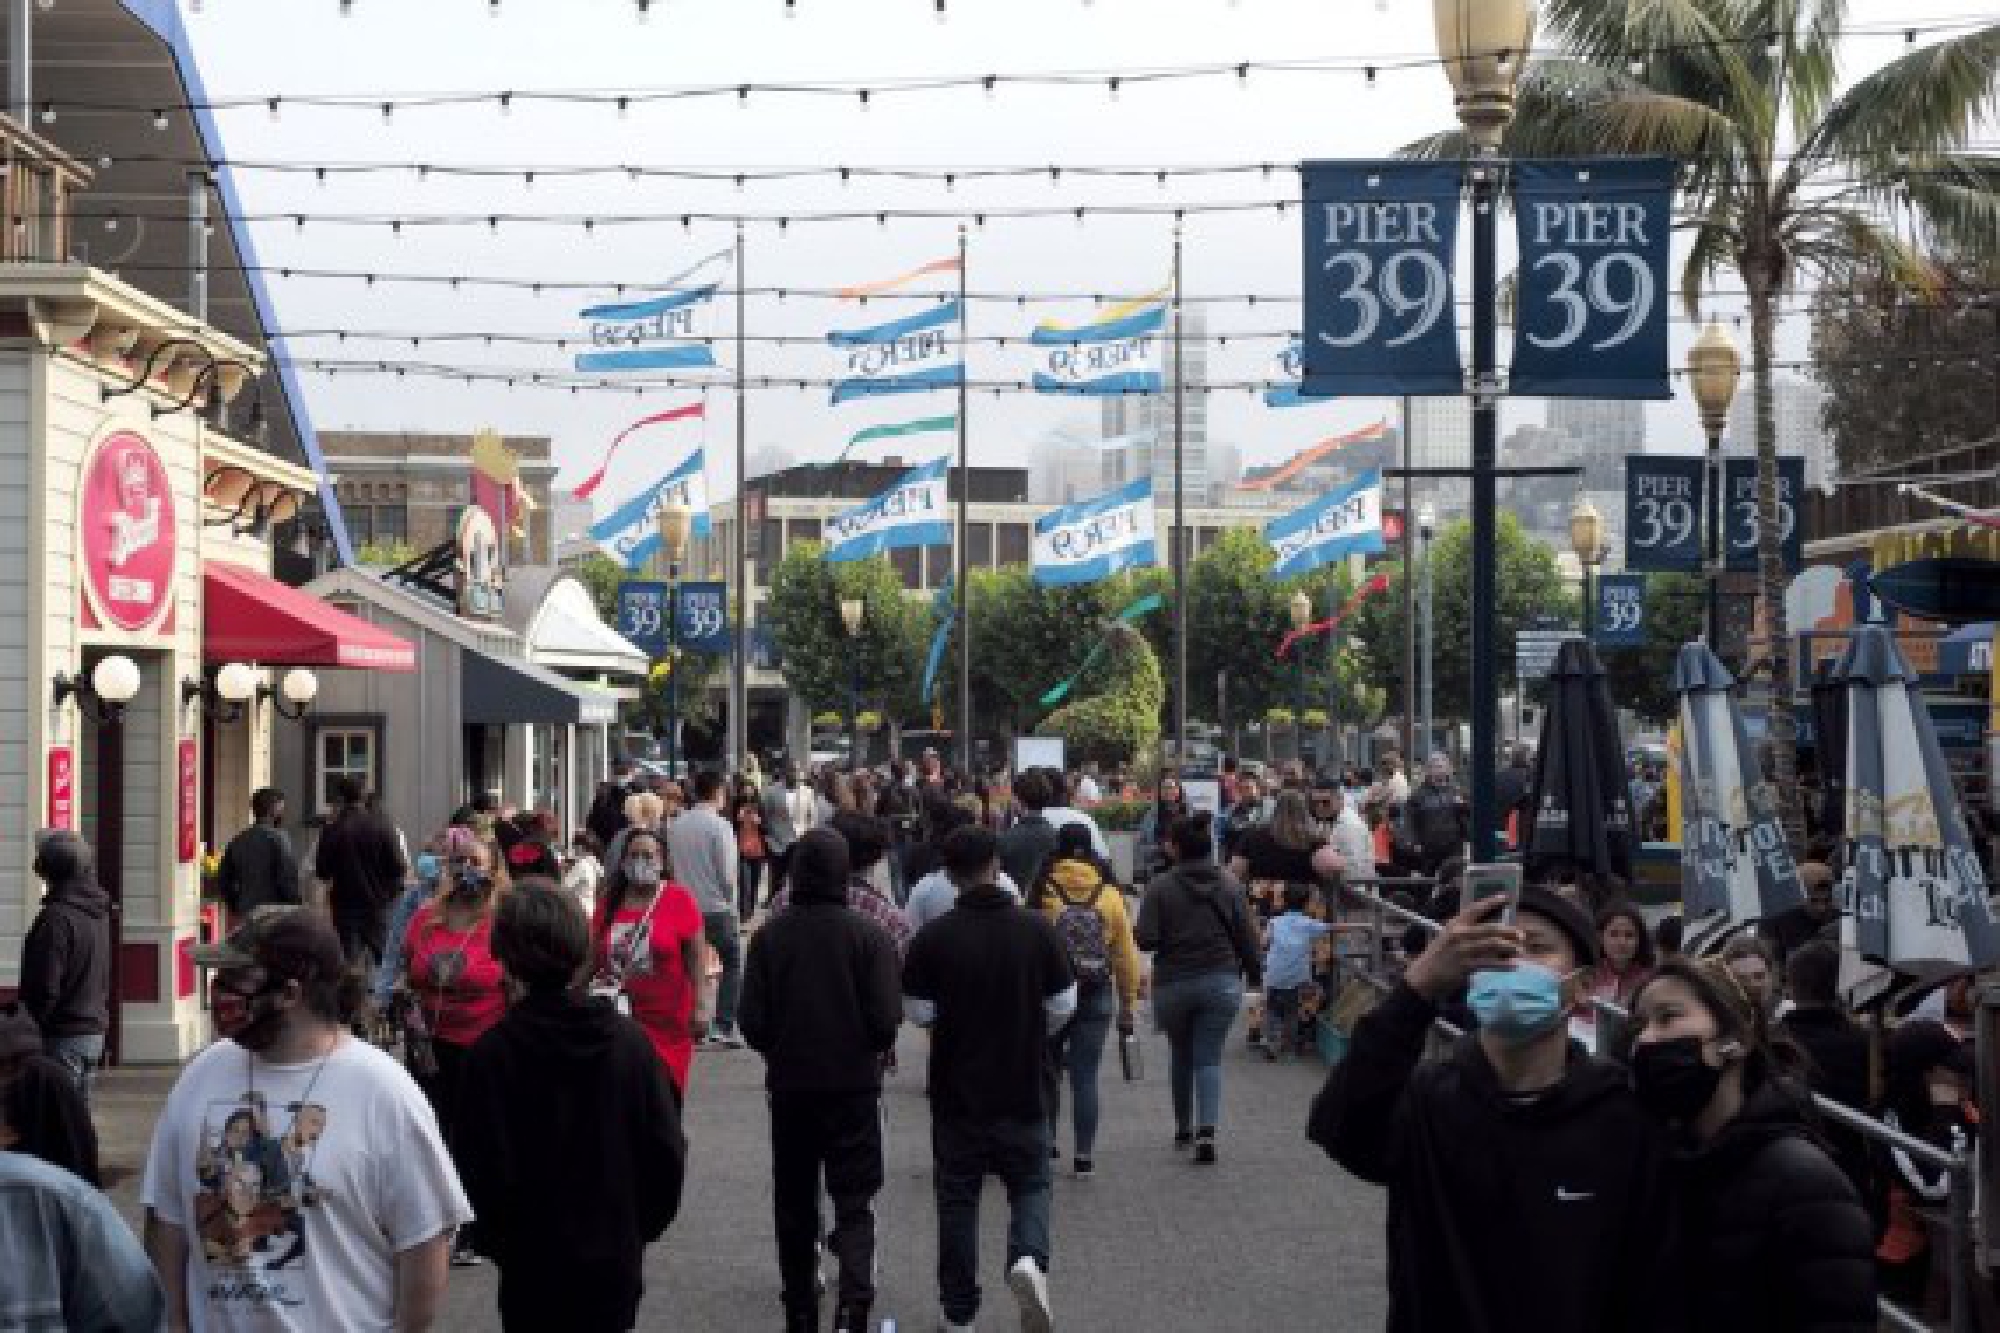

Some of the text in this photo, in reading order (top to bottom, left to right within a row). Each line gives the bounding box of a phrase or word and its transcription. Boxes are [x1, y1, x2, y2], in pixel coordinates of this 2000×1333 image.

[1323, 202, 1440, 243] PIER
[1532, 202, 1650, 244] PIER
[1318, 249, 1448, 349] 39
[1525, 252, 1655, 352] 39
[1637, 476, 1693, 497] PIER
[1633, 498, 1695, 548] 39
[624, 606, 661, 636] 39
[683, 606, 724, 639] 39
[1603, 601, 1642, 632] 39
